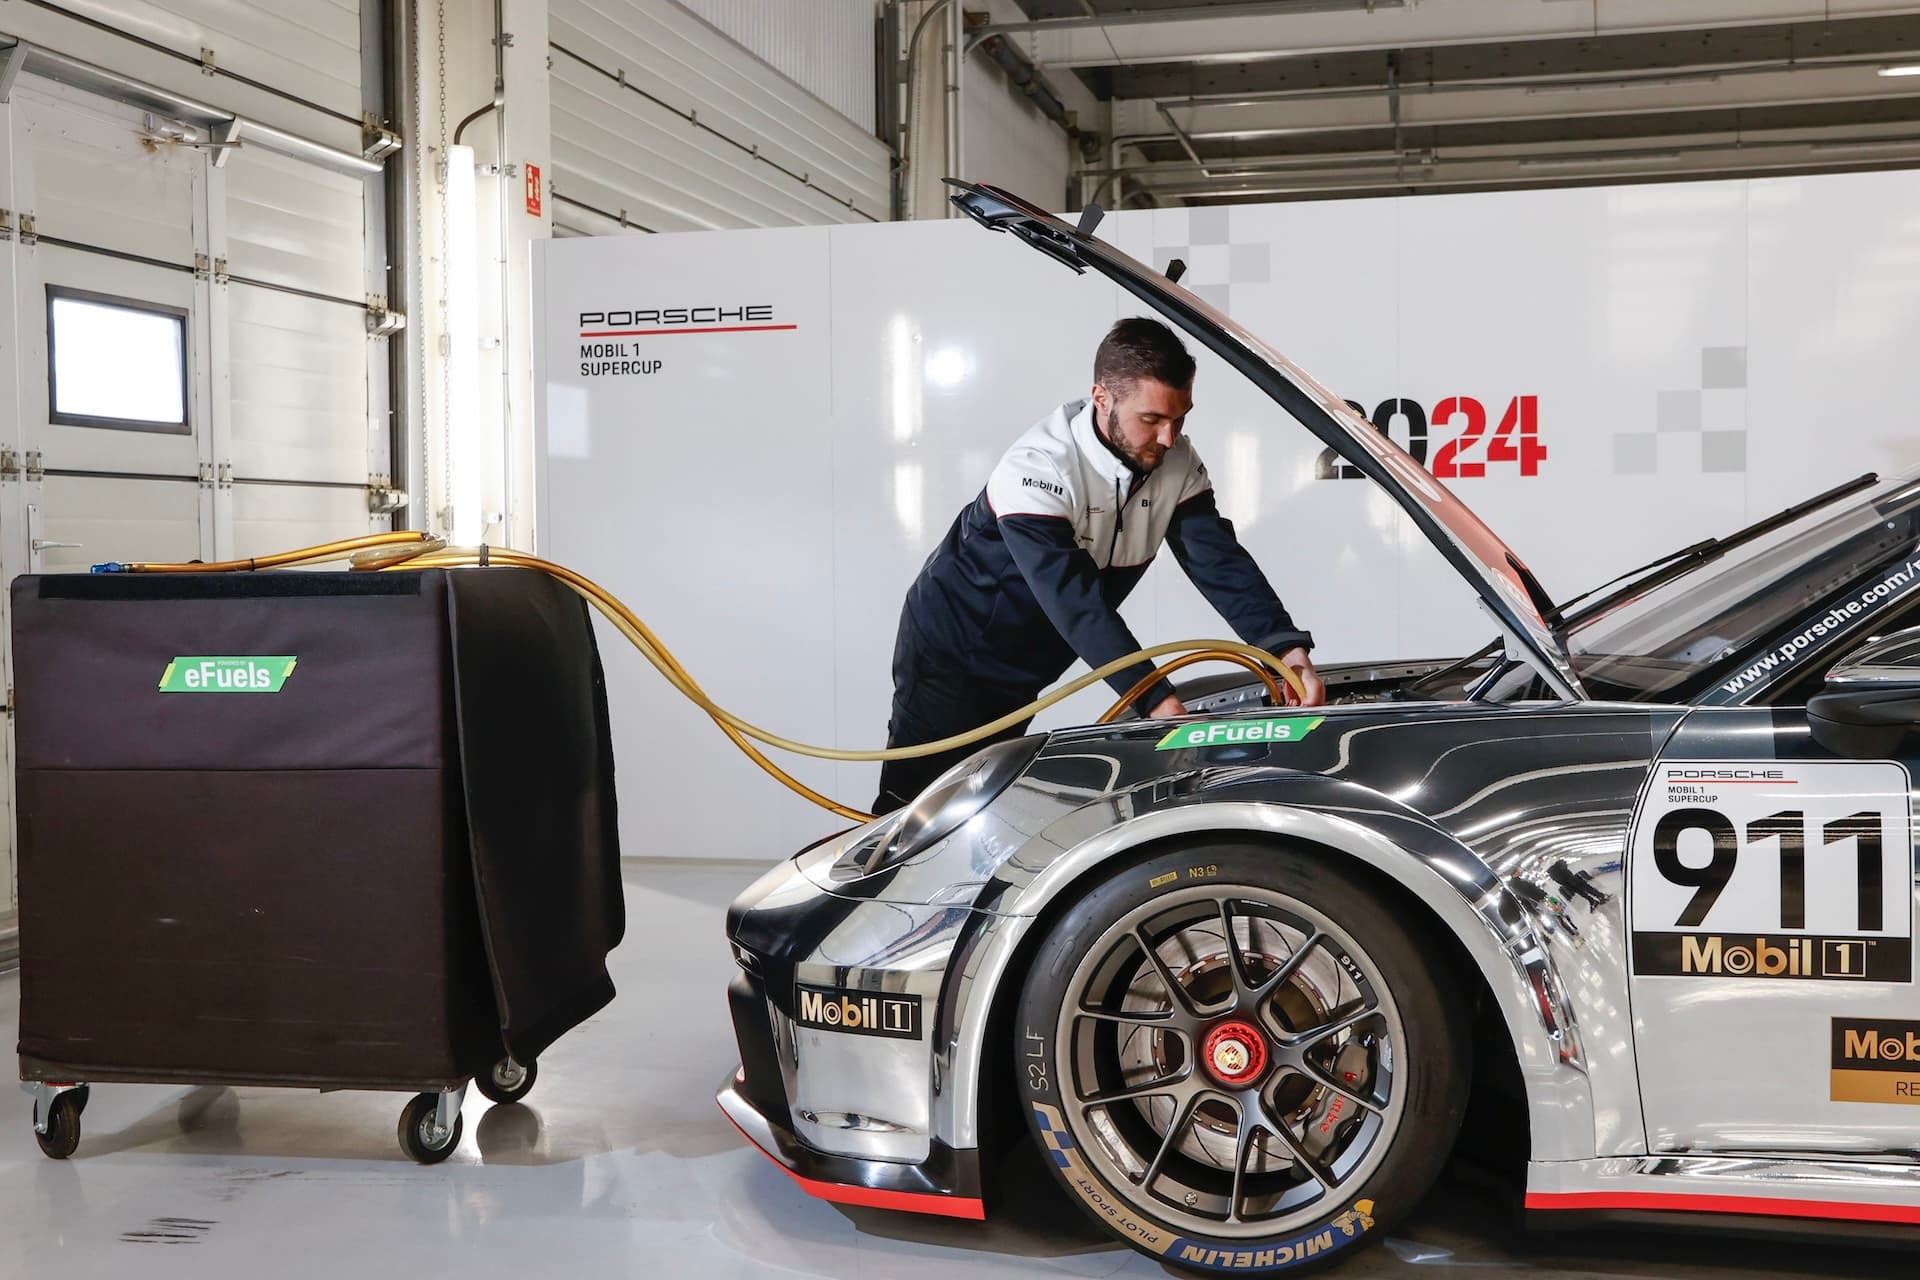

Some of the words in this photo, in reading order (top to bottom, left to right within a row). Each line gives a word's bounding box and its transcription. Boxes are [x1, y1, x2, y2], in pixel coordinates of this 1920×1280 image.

[580, 305, 773, 327] PORSCHE
[580, 343, 628, 358] MOBIL
[632, 343, 640, 357] 1
[580, 360, 662, 376] SUPERCUP
[1022, 477, 1053, 492] Mobil
[1722, 559, 1920, 695] www.porsche.com/
[184, 661, 271, 688] eFuels
[1187, 721, 1291, 744] eFuels
[1667, 770, 1784, 779] PORSCHE
[1668, 786, 1697, 794] MOBIL
[1668, 795, 1718, 803] SUPERCUP
[1188, 867, 1205, 879] N3
[1653, 808, 1883, 932] 911
[1340, 955, 1362, 980] 911
[1681, 935, 1812, 977] Mobil
[800, 990, 878, 1029] Mobil
[1077, 1179, 1117, 1216] SPORT
[1116, 1218, 1159, 1243] PILOT
[1179, 1230, 1333, 1267] MICHELIN
